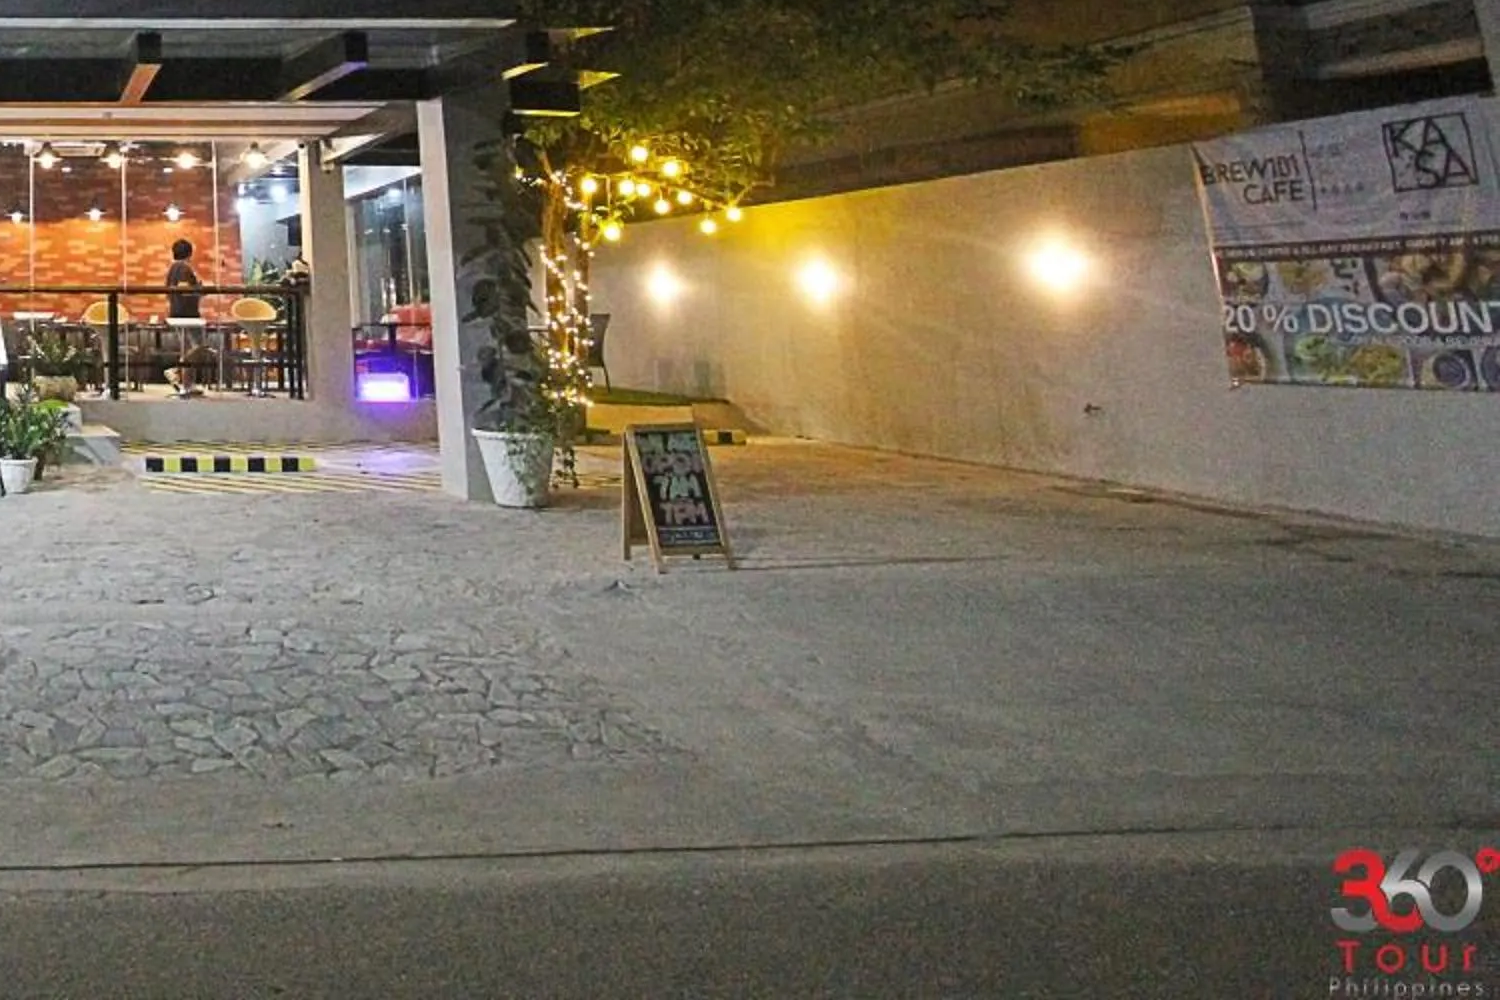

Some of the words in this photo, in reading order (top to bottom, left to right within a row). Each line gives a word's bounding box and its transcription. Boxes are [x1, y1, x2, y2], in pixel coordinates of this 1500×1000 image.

[1243, 180, 1305, 206] CAFE
[1223, 303, 1256, 334] 20
[1263, 302, 1299, 334] %
